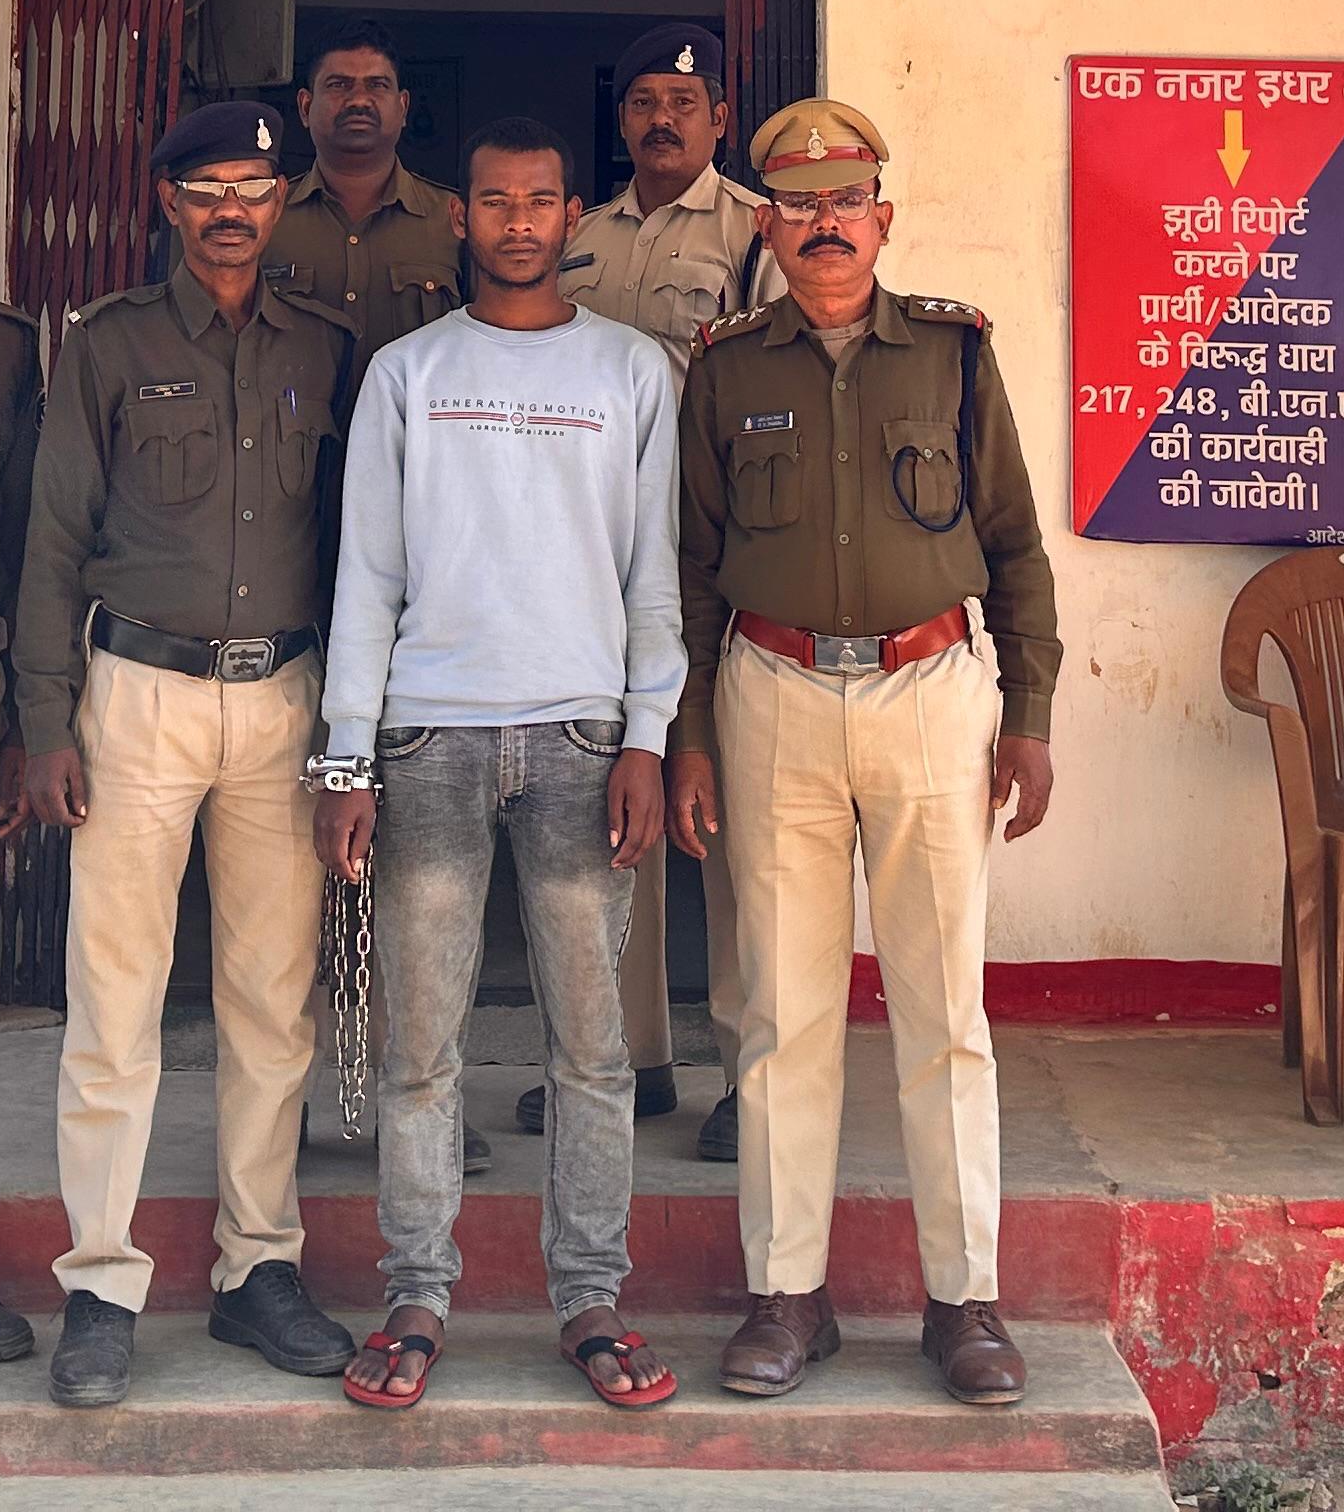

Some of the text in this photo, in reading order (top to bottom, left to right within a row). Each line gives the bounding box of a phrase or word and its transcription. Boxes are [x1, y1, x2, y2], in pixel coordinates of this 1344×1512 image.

[1077, 65, 1145, 100] एक
[1154, 68, 1247, 102] नजर
[1255, 69, 1333, 108] इधर
[1161, 195, 1310, 243] झूठी रिपोर्ट
[1172, 241, 1299, 281] करने पर
[1136, 330, 1172, 369] के
[1278, 343, 1336, 374] धारा
[429, 399, 605, 420] GENERATING MOTION
[1078, 384, 1146, 420] 217,
[1155, 386, 1230, 422] 248,
[1148, 422, 1328, 466] की कार्यवाही
[1158, 468, 1203, 508] की
